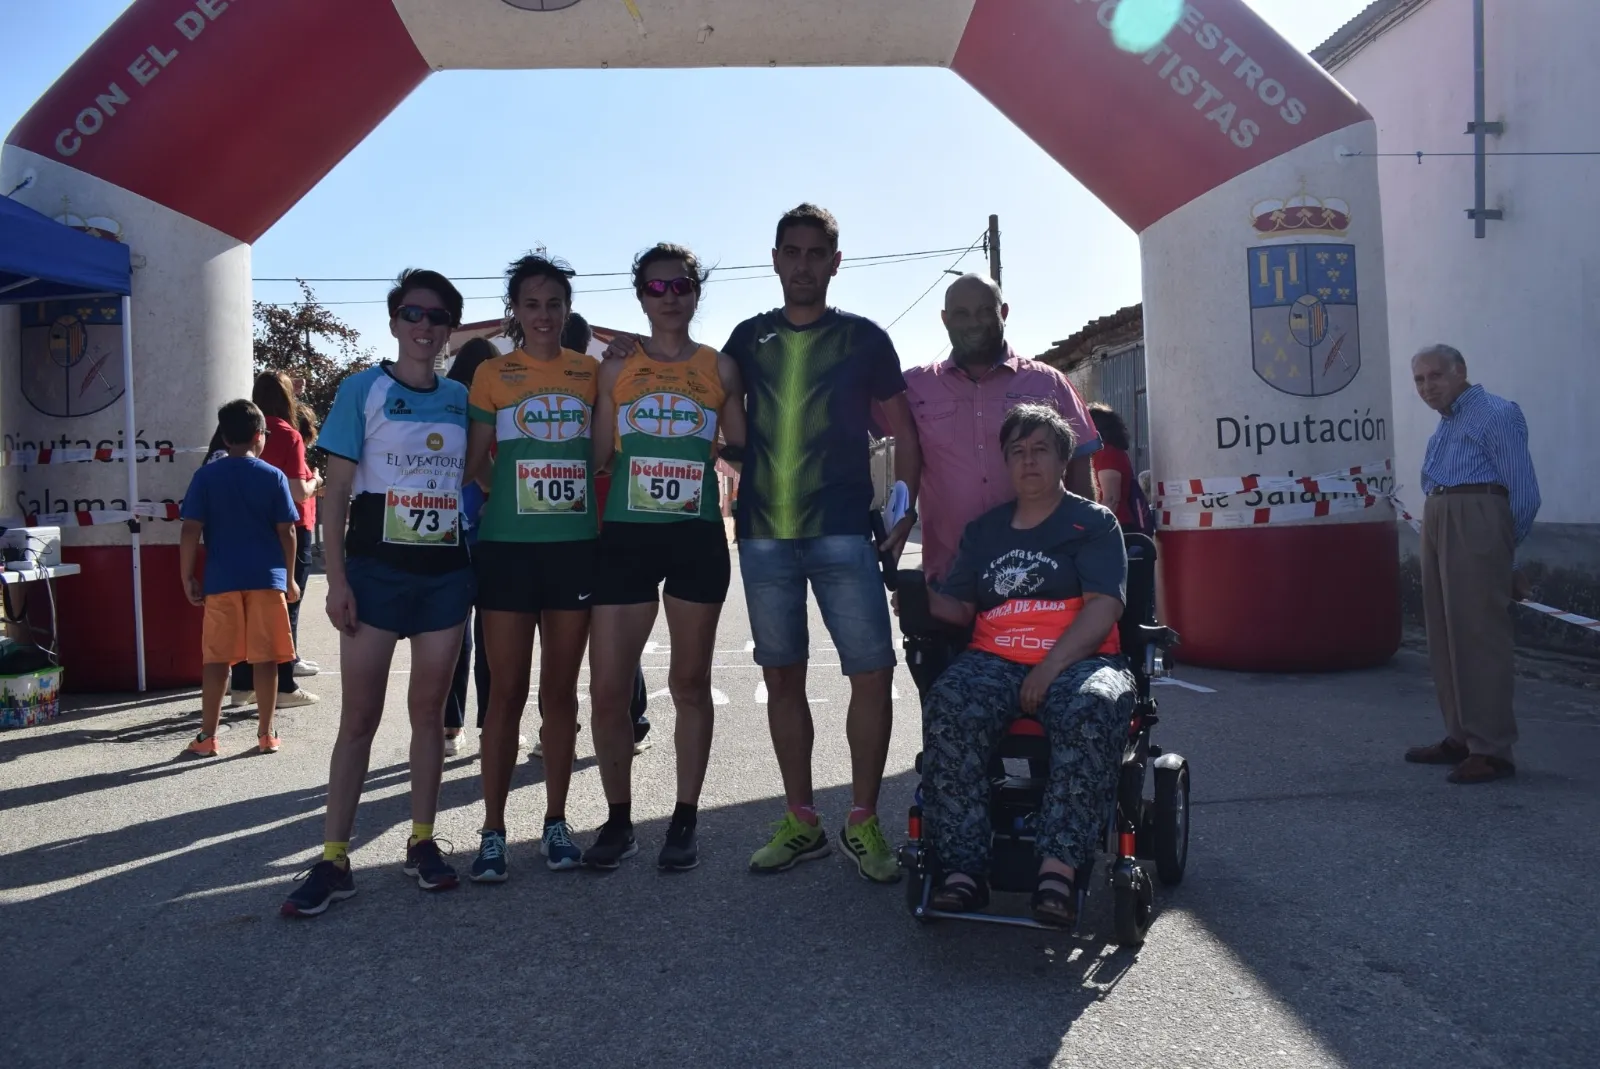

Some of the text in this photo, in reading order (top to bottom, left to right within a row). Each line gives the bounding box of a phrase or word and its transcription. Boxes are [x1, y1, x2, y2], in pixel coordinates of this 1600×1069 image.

[55, 82, 130, 157] CON
[127, 45, 179, 87] EL
[523, 409, 585, 426] ALCER
[632, 407, 699, 426] ALCER
[1216, 408, 1386, 455] Diputación
[386, 453, 402, 467] EL
[518, 464, 586, 480] bedunia
[631, 461, 702, 481] bedunia
[533, 480, 575, 501] 105
[650, 478, 680, 500] 50
[387, 490, 458, 511] bedunia
[409, 509, 440, 532] 73
[1013, 600, 1032, 614] DE
